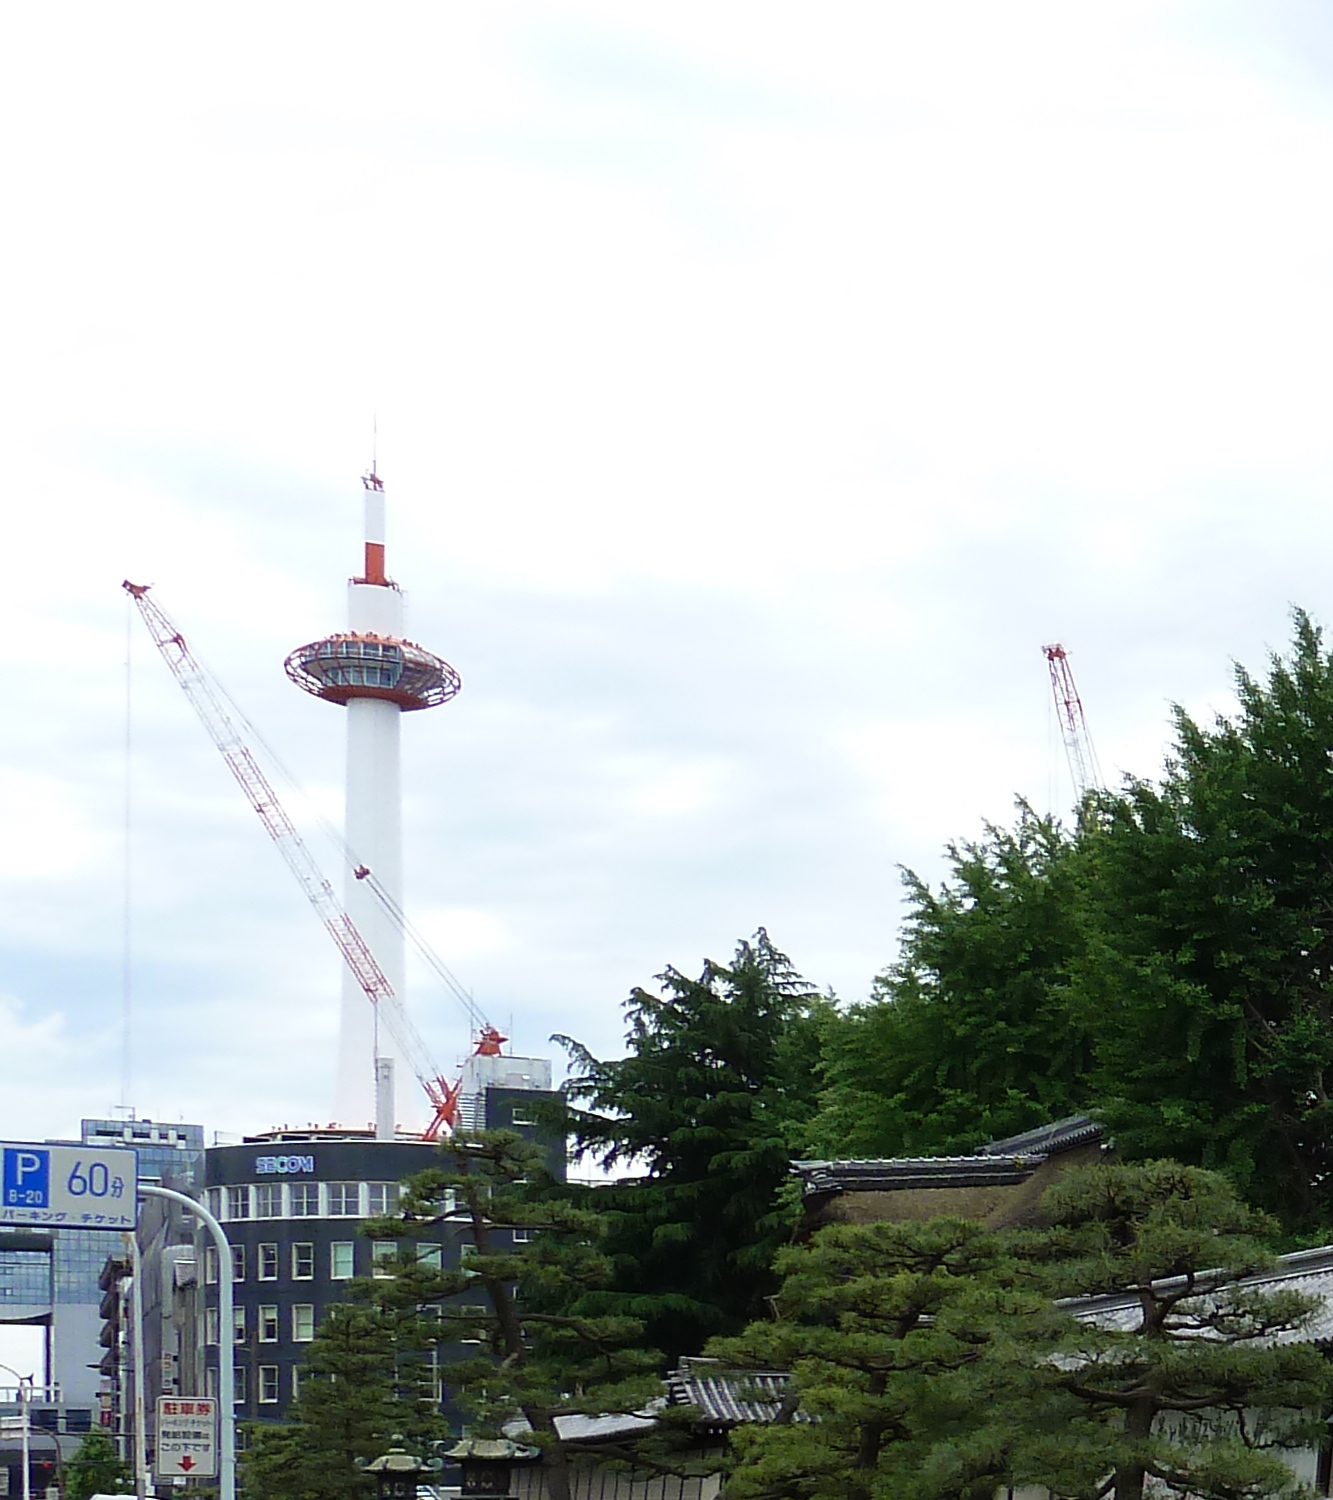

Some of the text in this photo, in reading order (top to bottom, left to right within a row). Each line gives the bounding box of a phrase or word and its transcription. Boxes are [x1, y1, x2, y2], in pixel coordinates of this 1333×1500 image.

[17, 1153, 41, 1185] P
[256, 1155, 314, 1174] SECOM
[68, 1161, 124, 1198] 60分
[9, 1189, 43, 1204] 8-20
[163, 1402, 212, 1415] 駐車券
[161, 1443, 211, 1452] この下です
